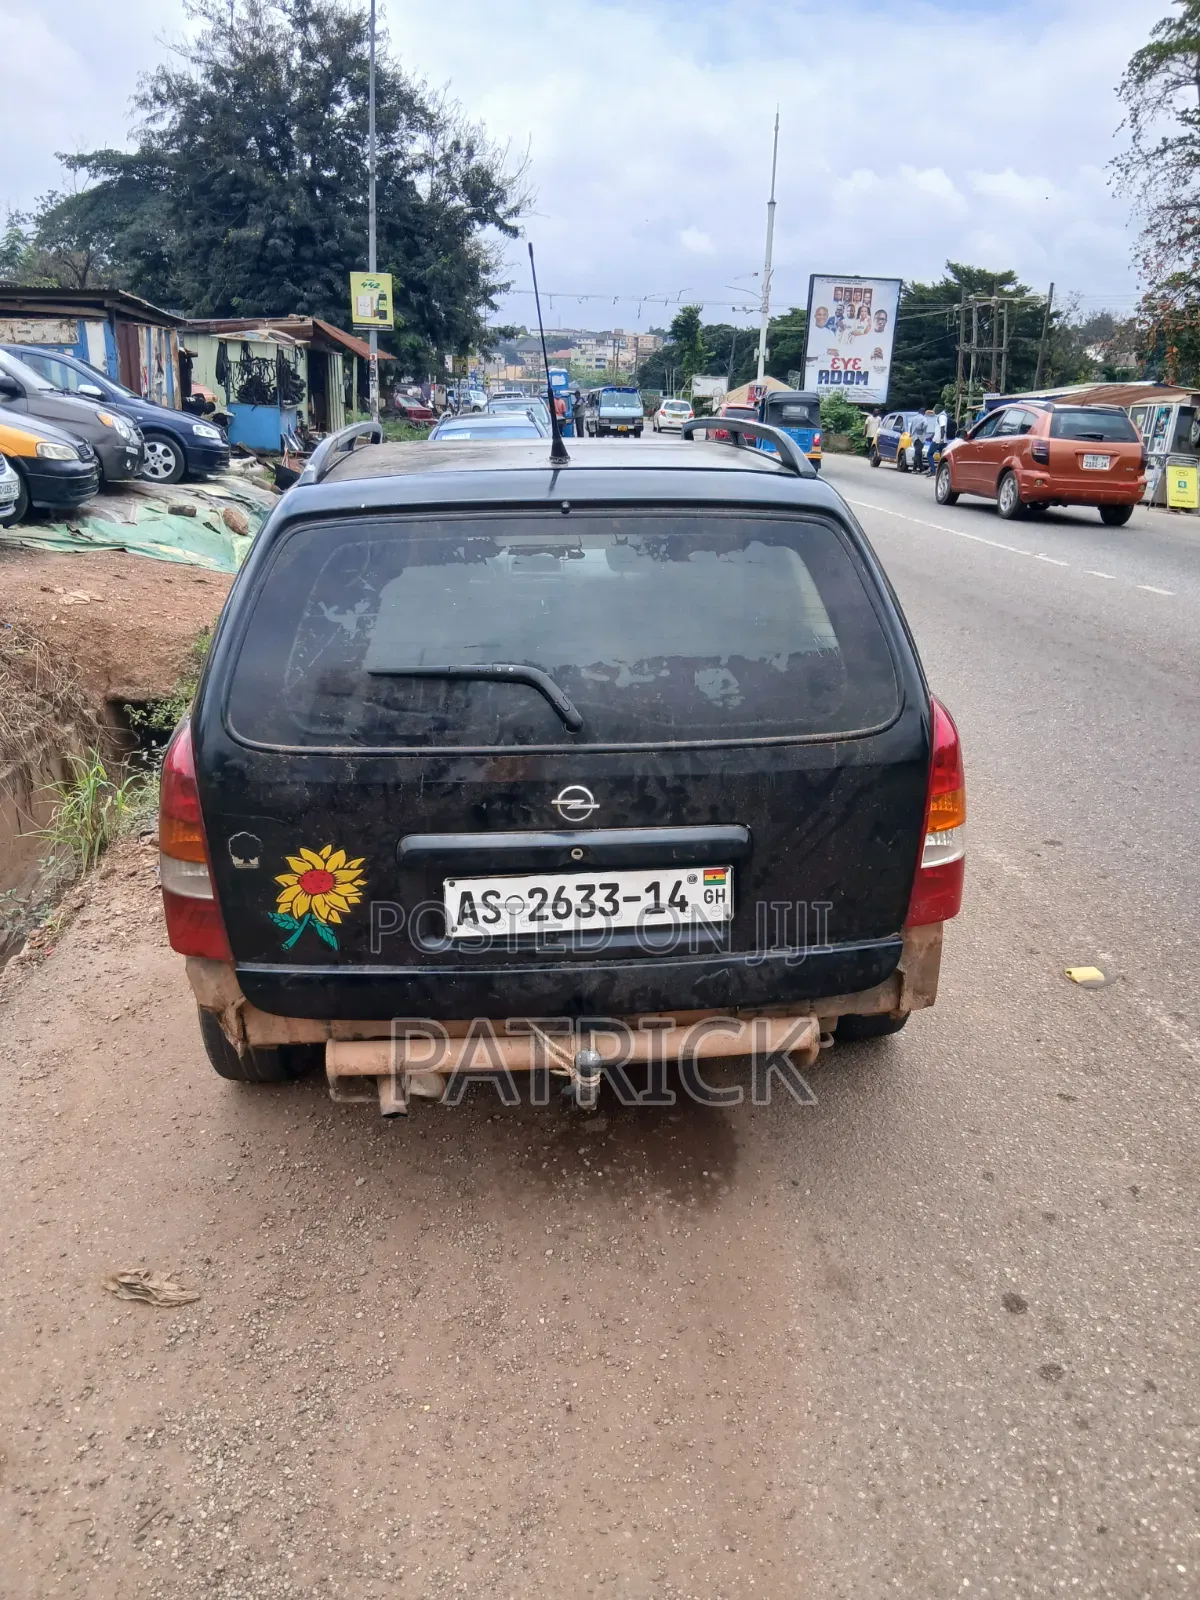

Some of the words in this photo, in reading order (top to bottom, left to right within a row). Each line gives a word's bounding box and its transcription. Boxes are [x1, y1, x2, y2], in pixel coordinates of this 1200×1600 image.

[817, 370, 869, 385] ADOM
[457, 889, 502, 925] AS
[527, 880, 688, 922] 2633-14
[703, 888, 726, 905] GH
